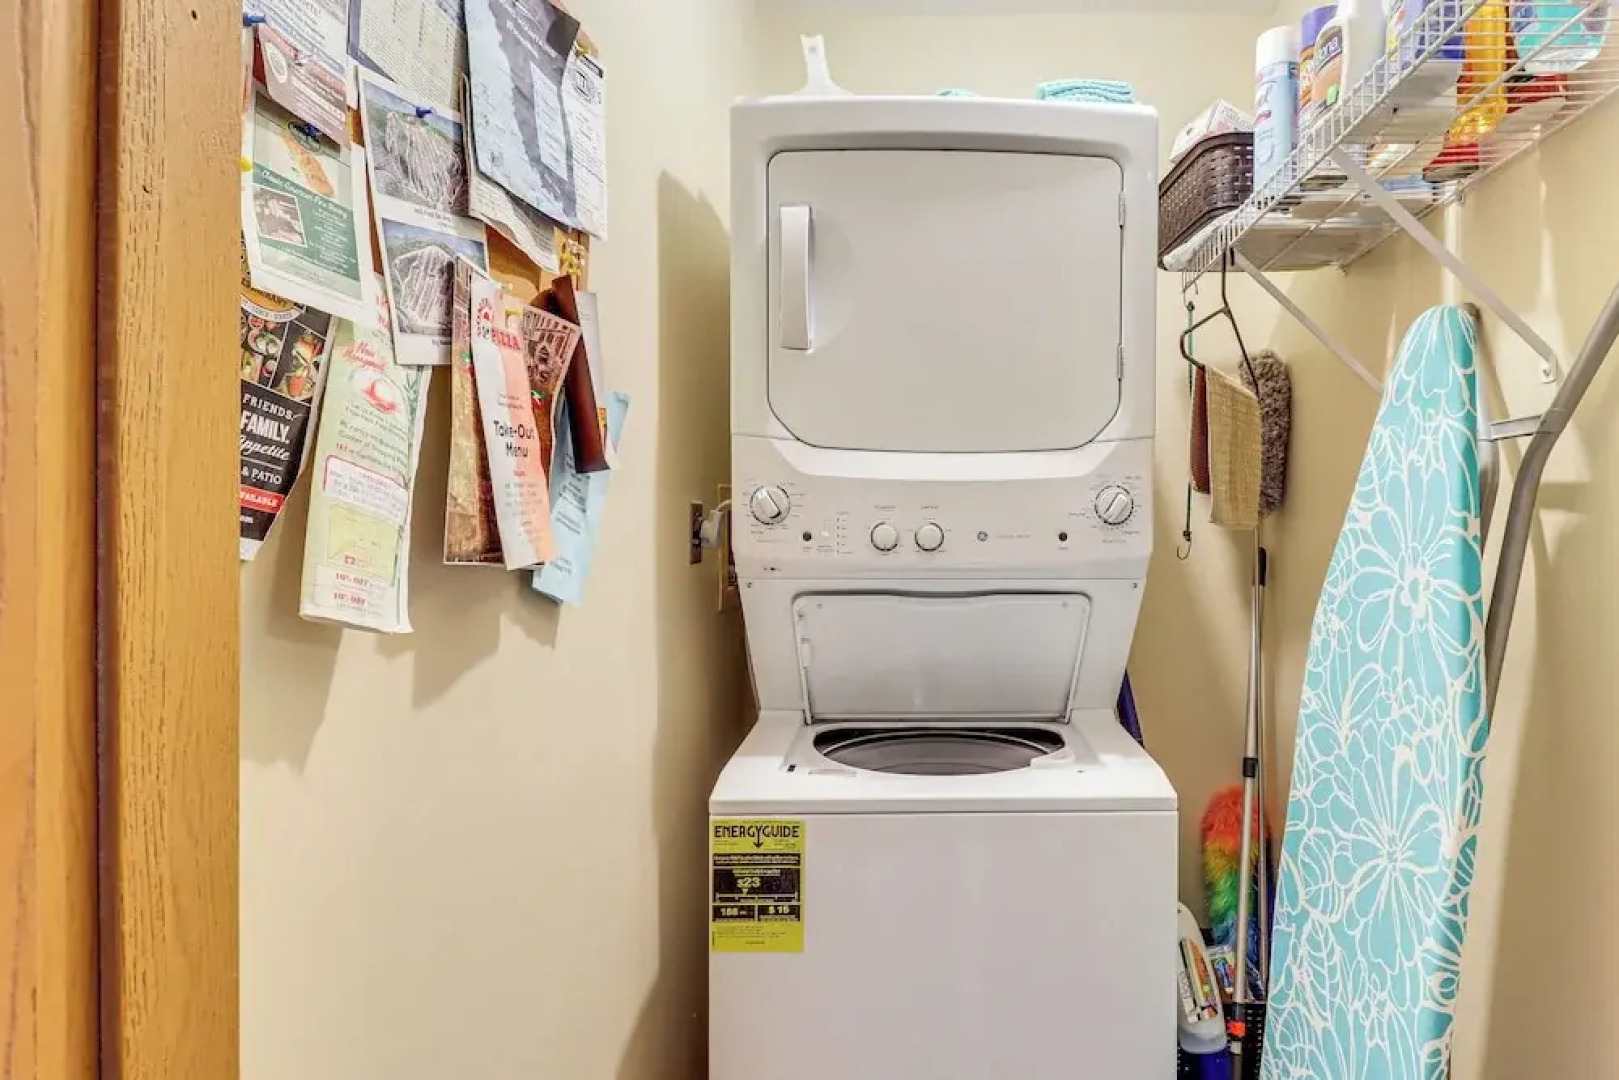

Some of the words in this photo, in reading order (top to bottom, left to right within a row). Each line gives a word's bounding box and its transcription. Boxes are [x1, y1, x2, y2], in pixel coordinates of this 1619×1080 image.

[491, 325, 520, 350] PIZZA
[241, 410, 291, 444] FAMILY.
[493, 420, 536, 440] Take-Out
[506, 441, 529, 458] Menu
[241, 466, 249, 478] &
[252, 468, 283, 485] PATIO
[240, 491, 279, 507] VAILABLE
[714, 824, 799, 840] ENERGYGUIDE
[737, 877, 761, 888] $23
